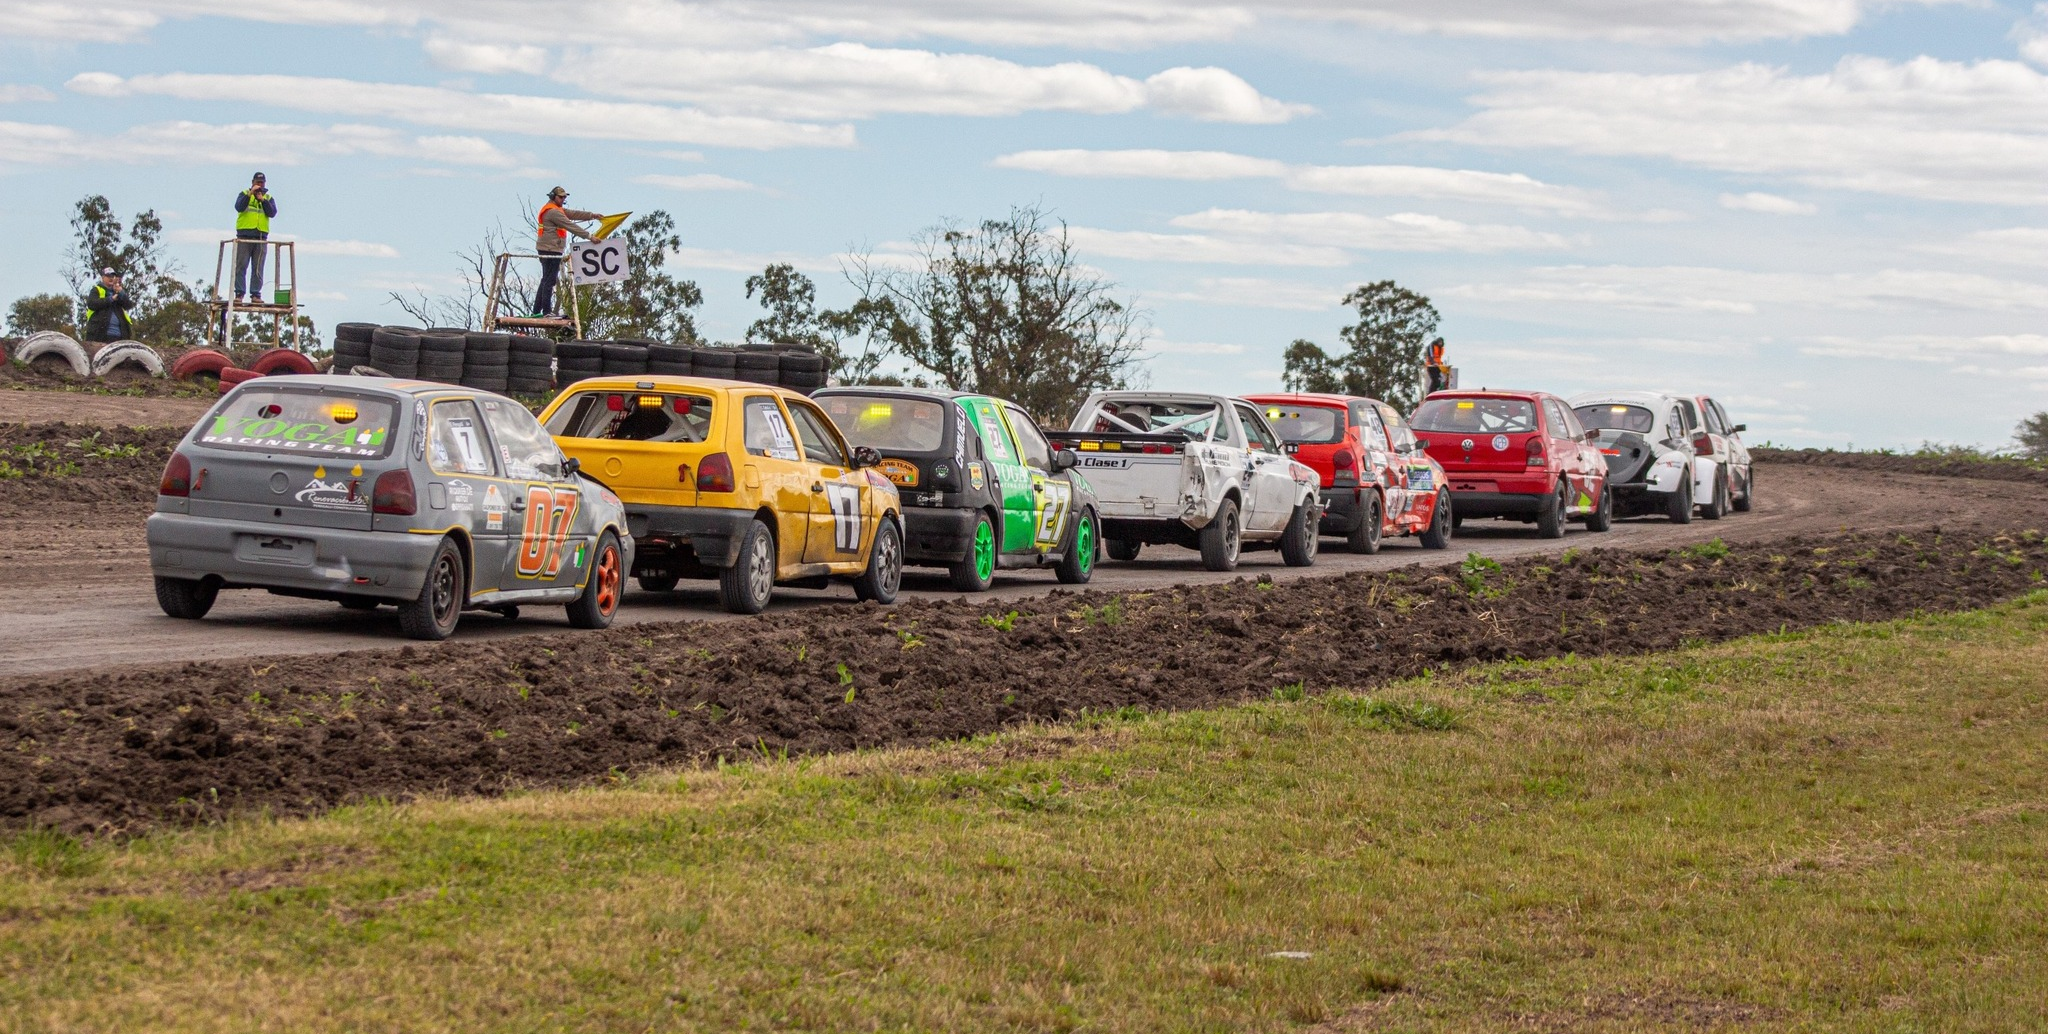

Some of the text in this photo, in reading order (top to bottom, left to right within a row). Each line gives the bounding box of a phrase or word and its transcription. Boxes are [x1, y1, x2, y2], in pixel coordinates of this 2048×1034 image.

[581, 246, 620, 277] SC
[214, 416, 359, 446] VOGA
[769, 414, 785, 438] 17
[202, 436, 376, 456] RACING TEAM
[460, 431, 472, 459] 7
[897, 462, 914, 472] TEAM
[1085, 457, 1119, 468] Clase
[1121, 458, 1128, 468] 1
[827, 484, 860, 550] 17
[1038, 484, 1070, 541] 27
[517, 483, 579, 578] 07
